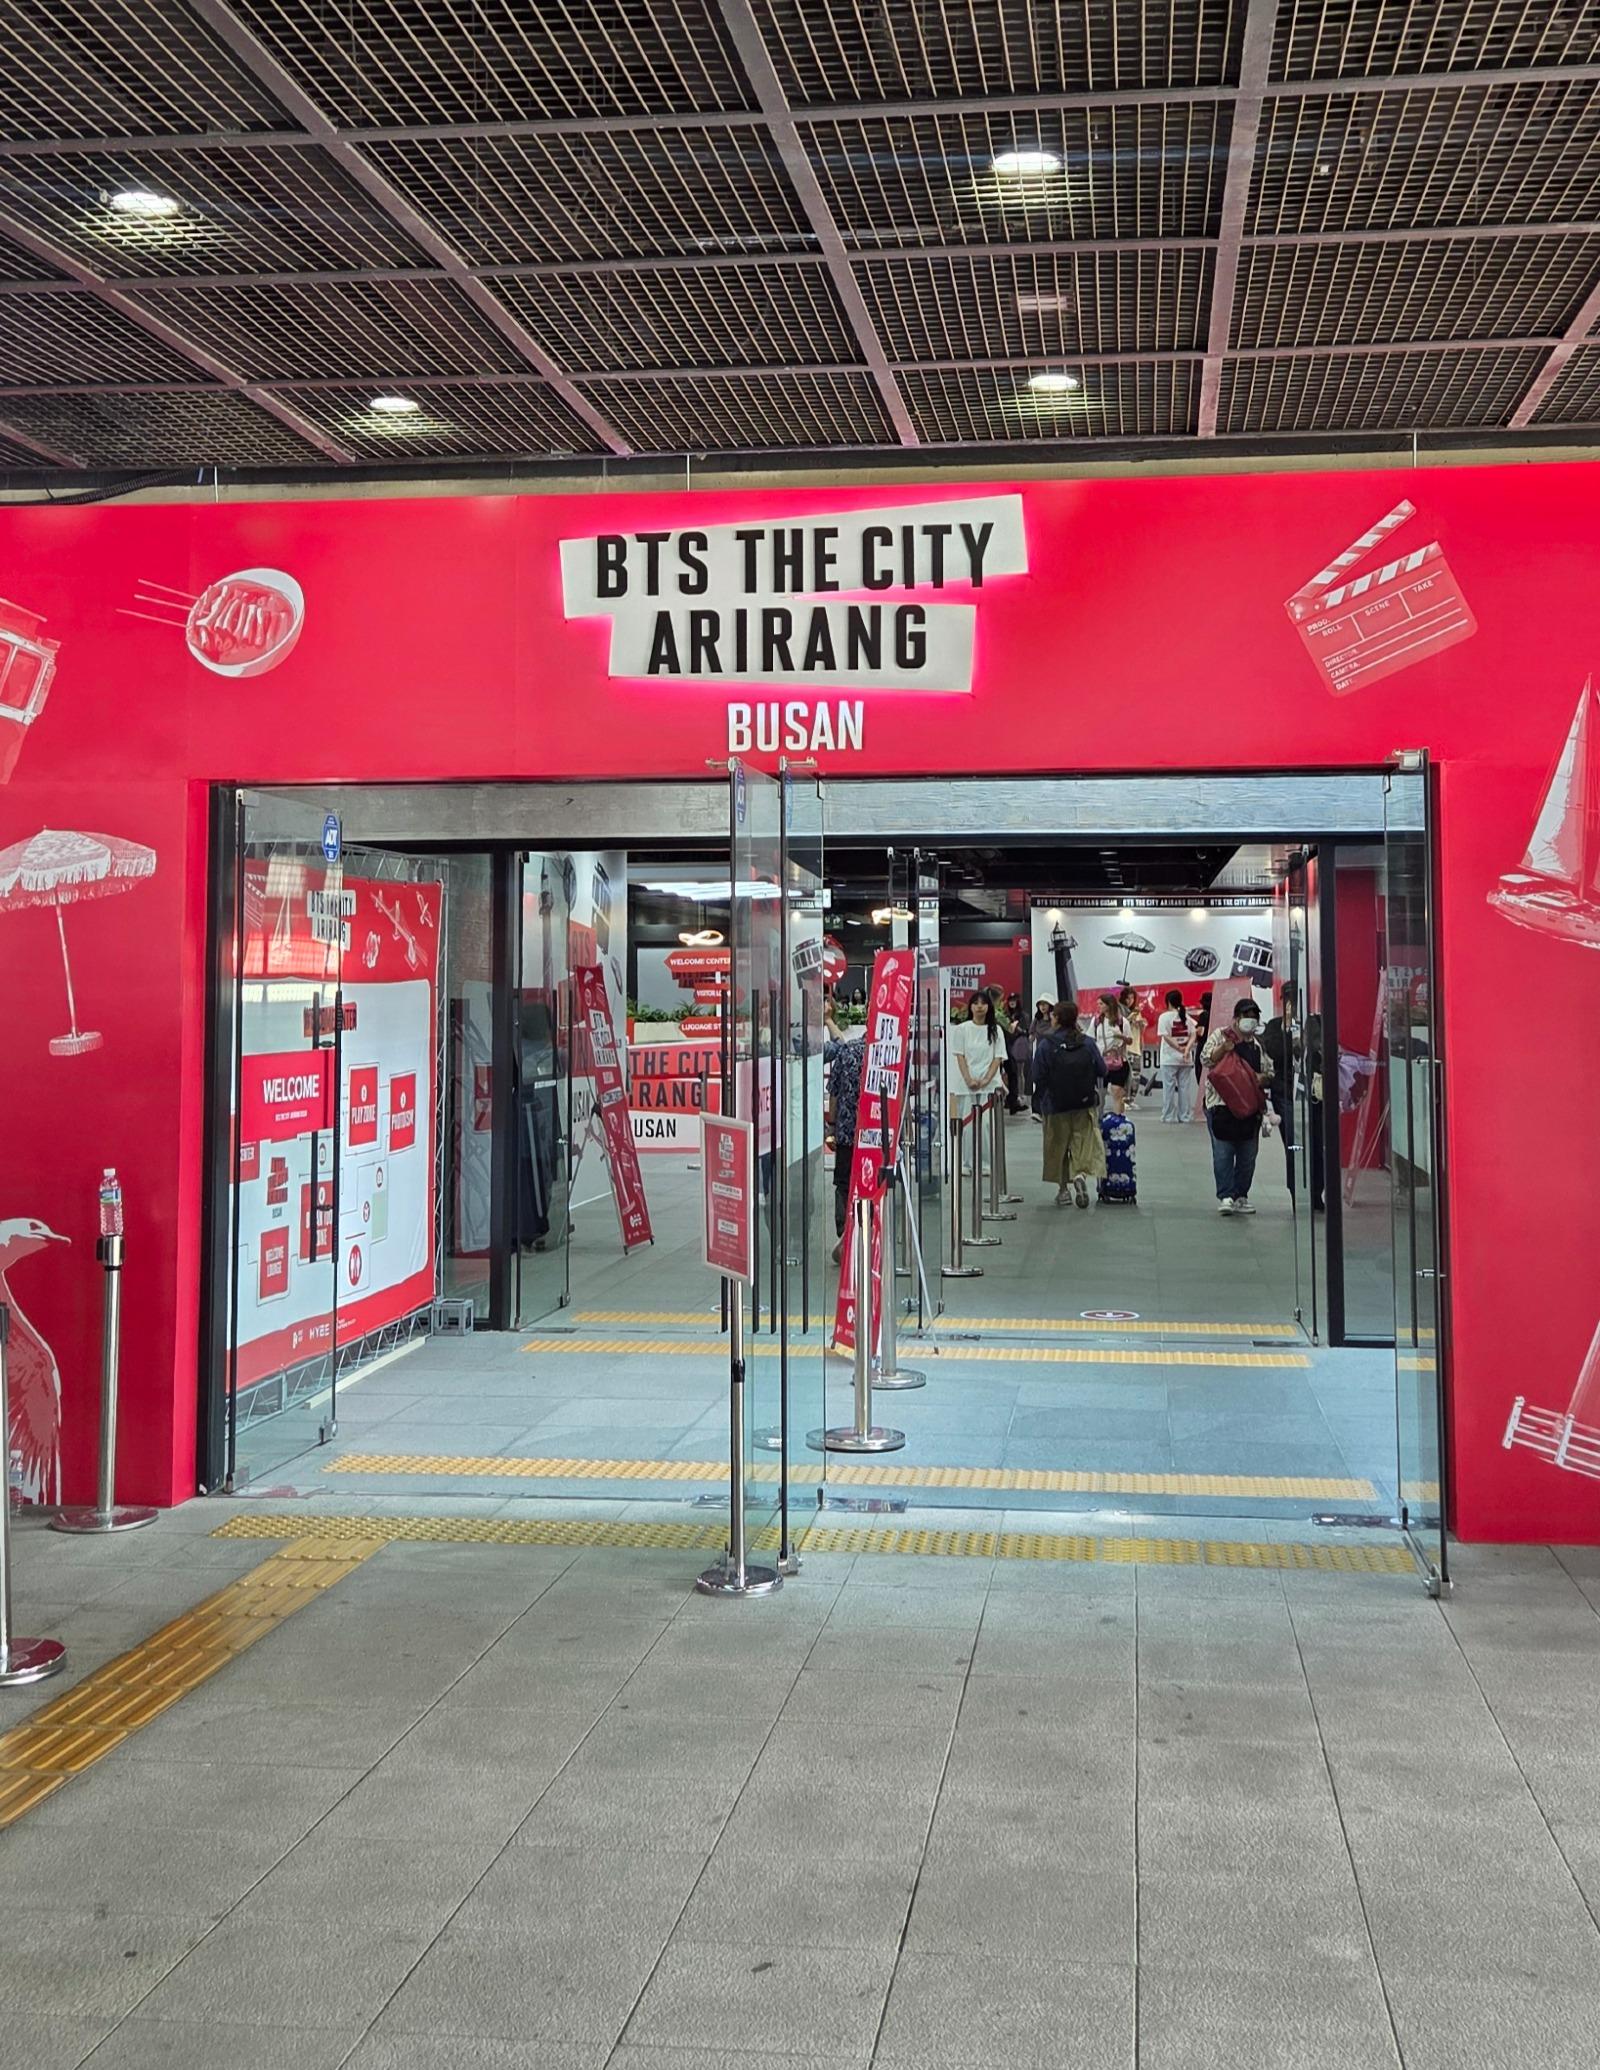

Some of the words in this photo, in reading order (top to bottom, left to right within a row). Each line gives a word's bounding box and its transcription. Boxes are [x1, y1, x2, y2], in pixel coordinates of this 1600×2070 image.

[597, 531, 708, 599] BTS
[735, 527, 839, 595] THE
[862, 522, 995, 591] CITY
[1412, 580, 1434, 593] TAKE
[1364, 600, 1390, 616] SCENE
[1321, 624, 1343, 637] ROLL
[647, 605, 926, 675] ARIRANG
[727, 701, 865, 753] BUSAN
[670, 958, 705, 966] WELCOME
[963, 966, 982, 977] CITY
[950, 978, 973, 988] RANG
[681, 1023, 712, 1031] LUGGAGE
[880, 1018, 894, 1041] BTS
[630, 1051, 670, 1075] THE
[871, 1044, 883, 1066] THE
[884, 1043, 900, 1066] CITY
[263, 1074, 320, 1104] WELCOME
[634, 1118, 677, 1138] USAN
[309, 1323, 331, 1340] HYBE
